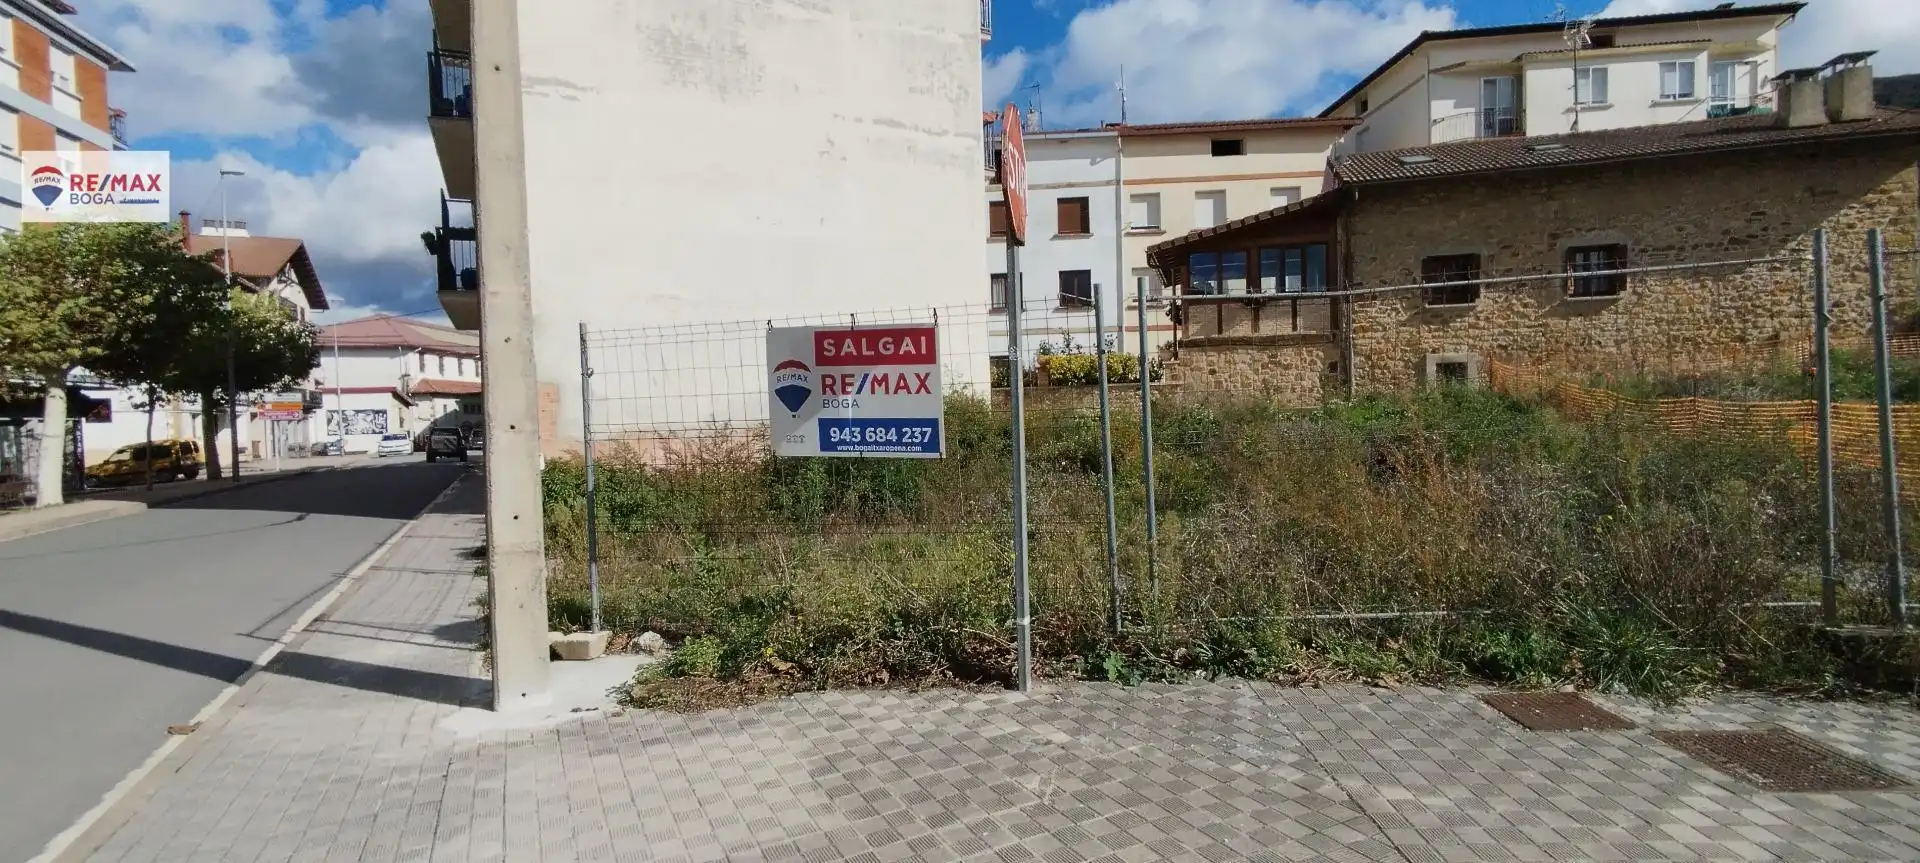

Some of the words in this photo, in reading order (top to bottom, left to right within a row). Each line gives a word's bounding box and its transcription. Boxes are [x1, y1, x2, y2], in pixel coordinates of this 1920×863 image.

[1008, 143, 1026, 194] ST
[823, 336, 927, 356] SALGAI
[776, 373, 809, 384] RE/MAX
[821, 372, 932, 396] RE/MAX
[822, 398, 860, 409] BOGA
[829, 427, 862, 443] 943
[865, 427, 898, 442] 684
[901, 427, 932, 443] 237
